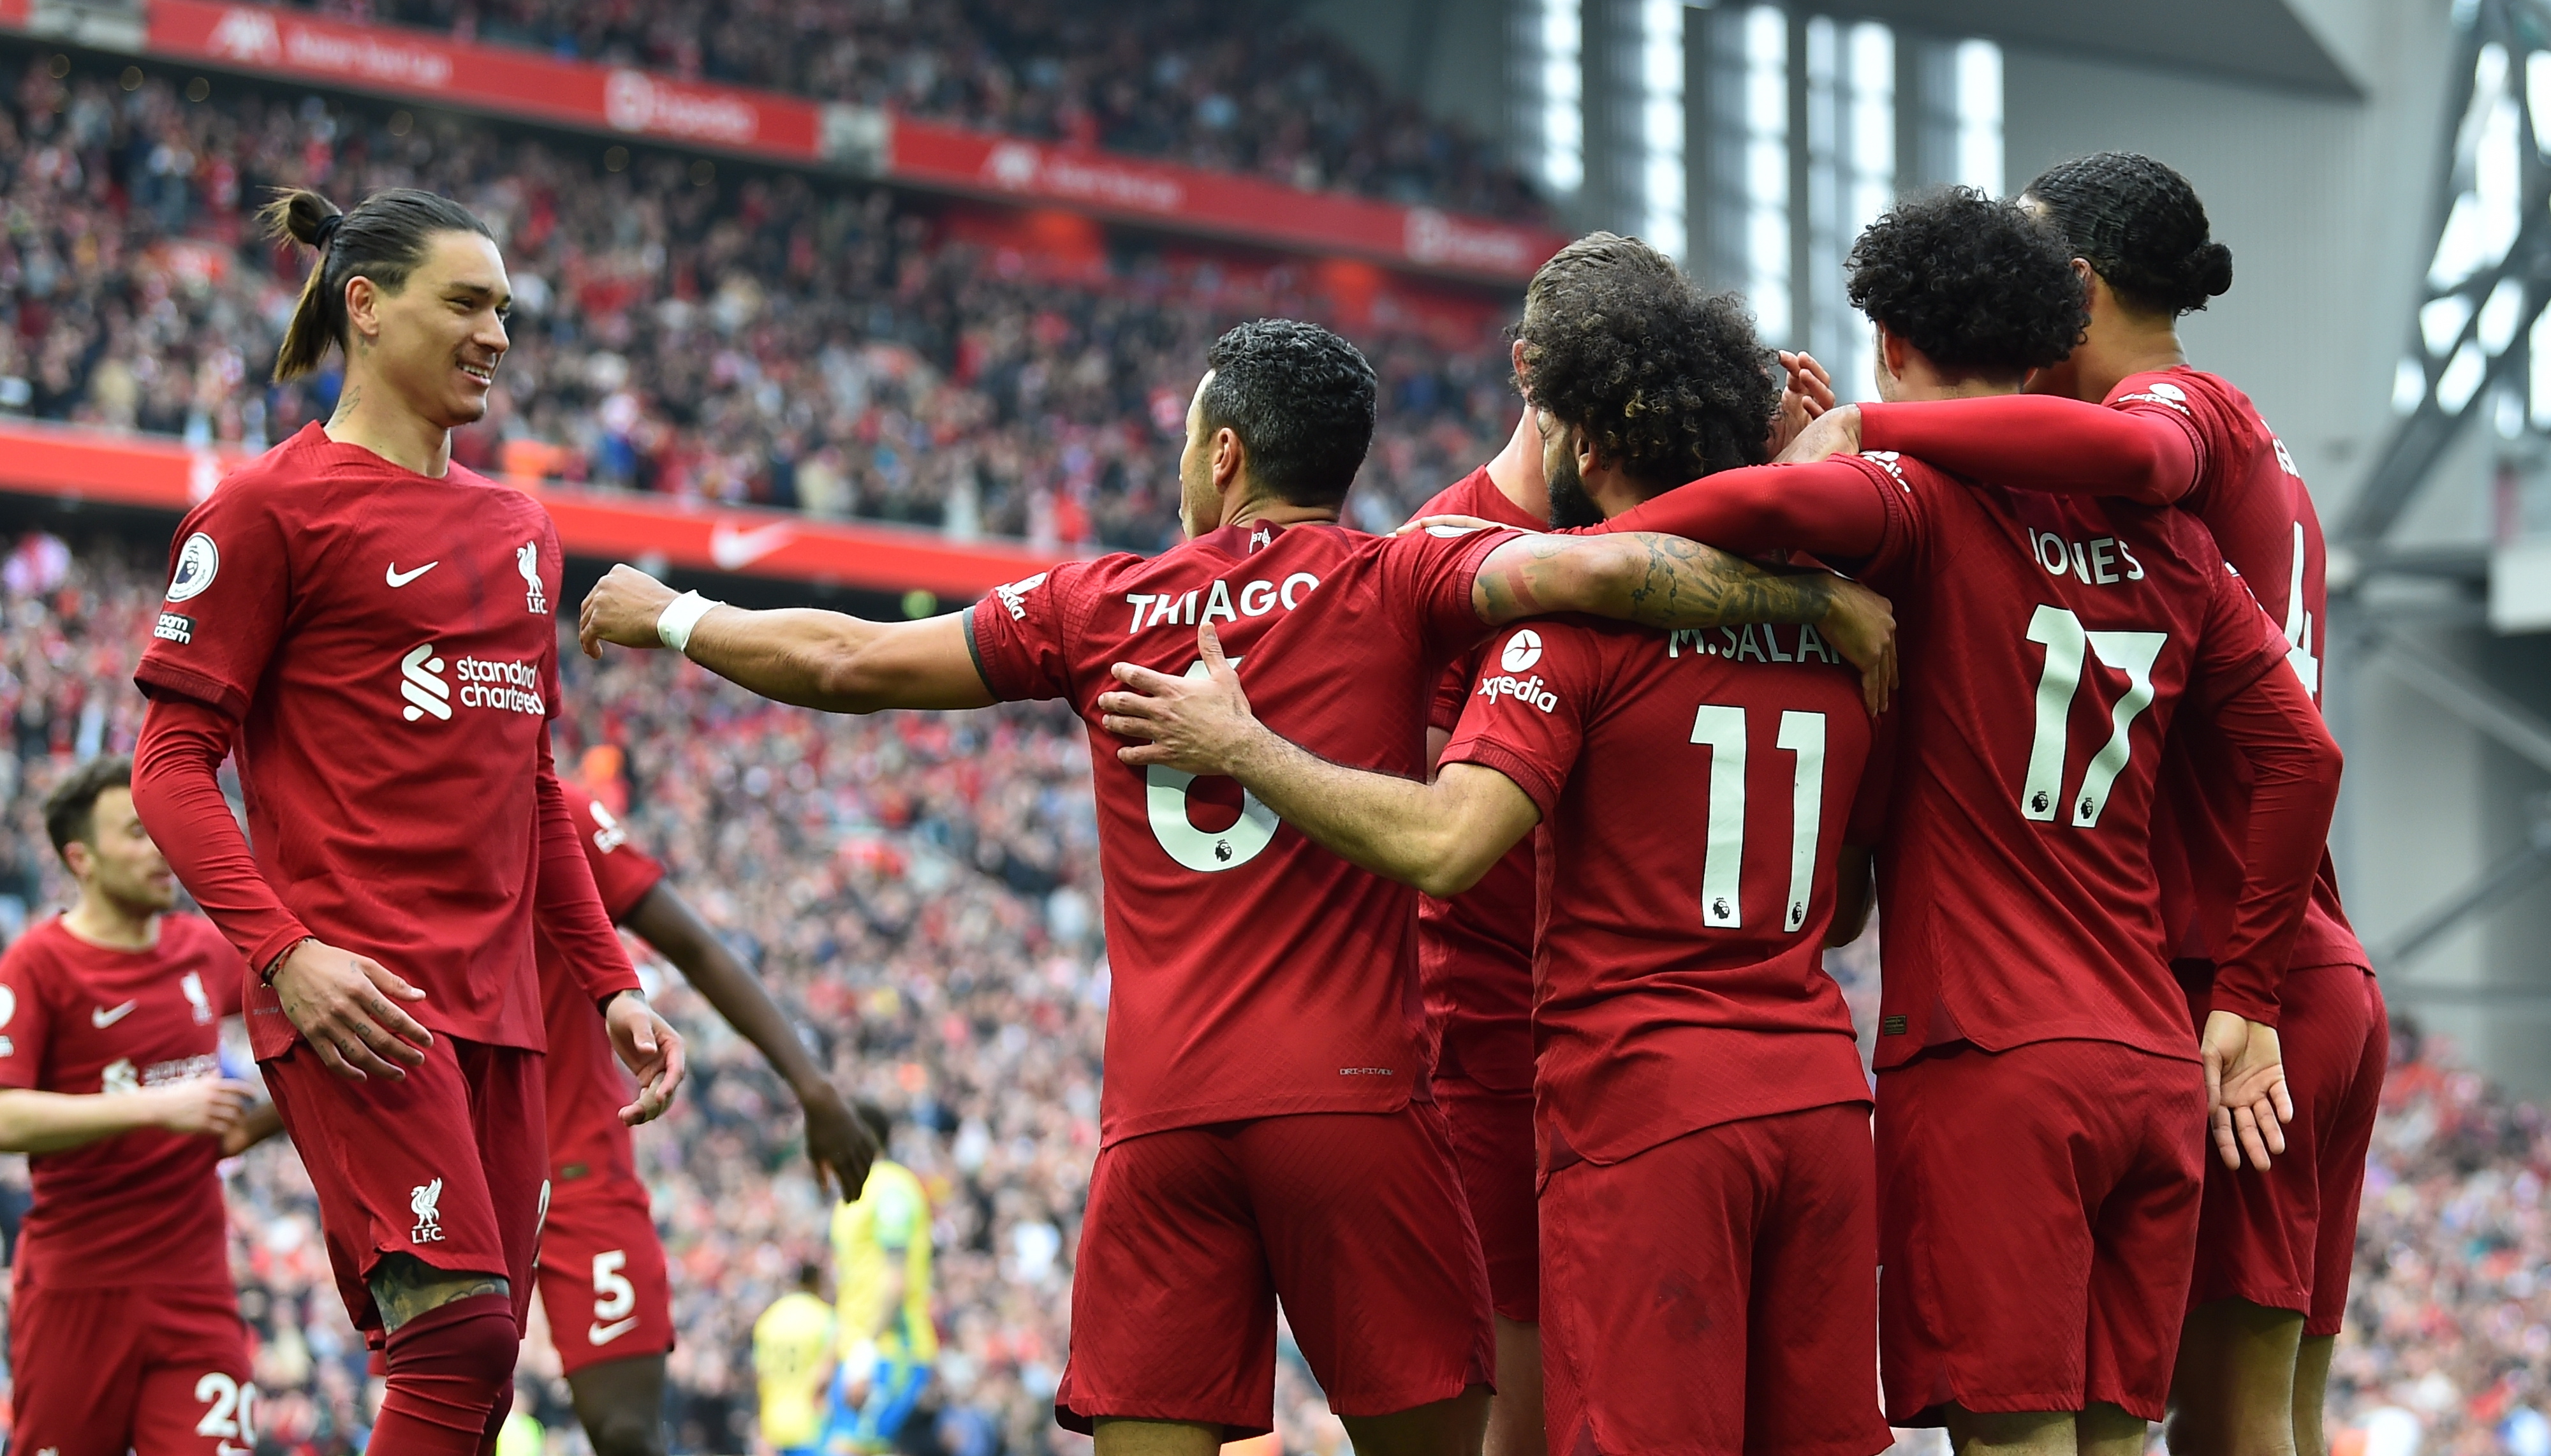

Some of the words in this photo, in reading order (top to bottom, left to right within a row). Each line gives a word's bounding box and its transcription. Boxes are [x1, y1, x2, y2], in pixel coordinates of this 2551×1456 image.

[1126, 571, 1320, 635] THIAGO
[2284, 520, 2318, 702] 4
[1668, 622, 1841, 665] M.SALA
[2020, 603, 2168, 828] 17
[1689, 704, 1826, 932] 11
[411, 1226, 446, 1244] L.F.C.
[592, 1249, 636, 1321] 5
